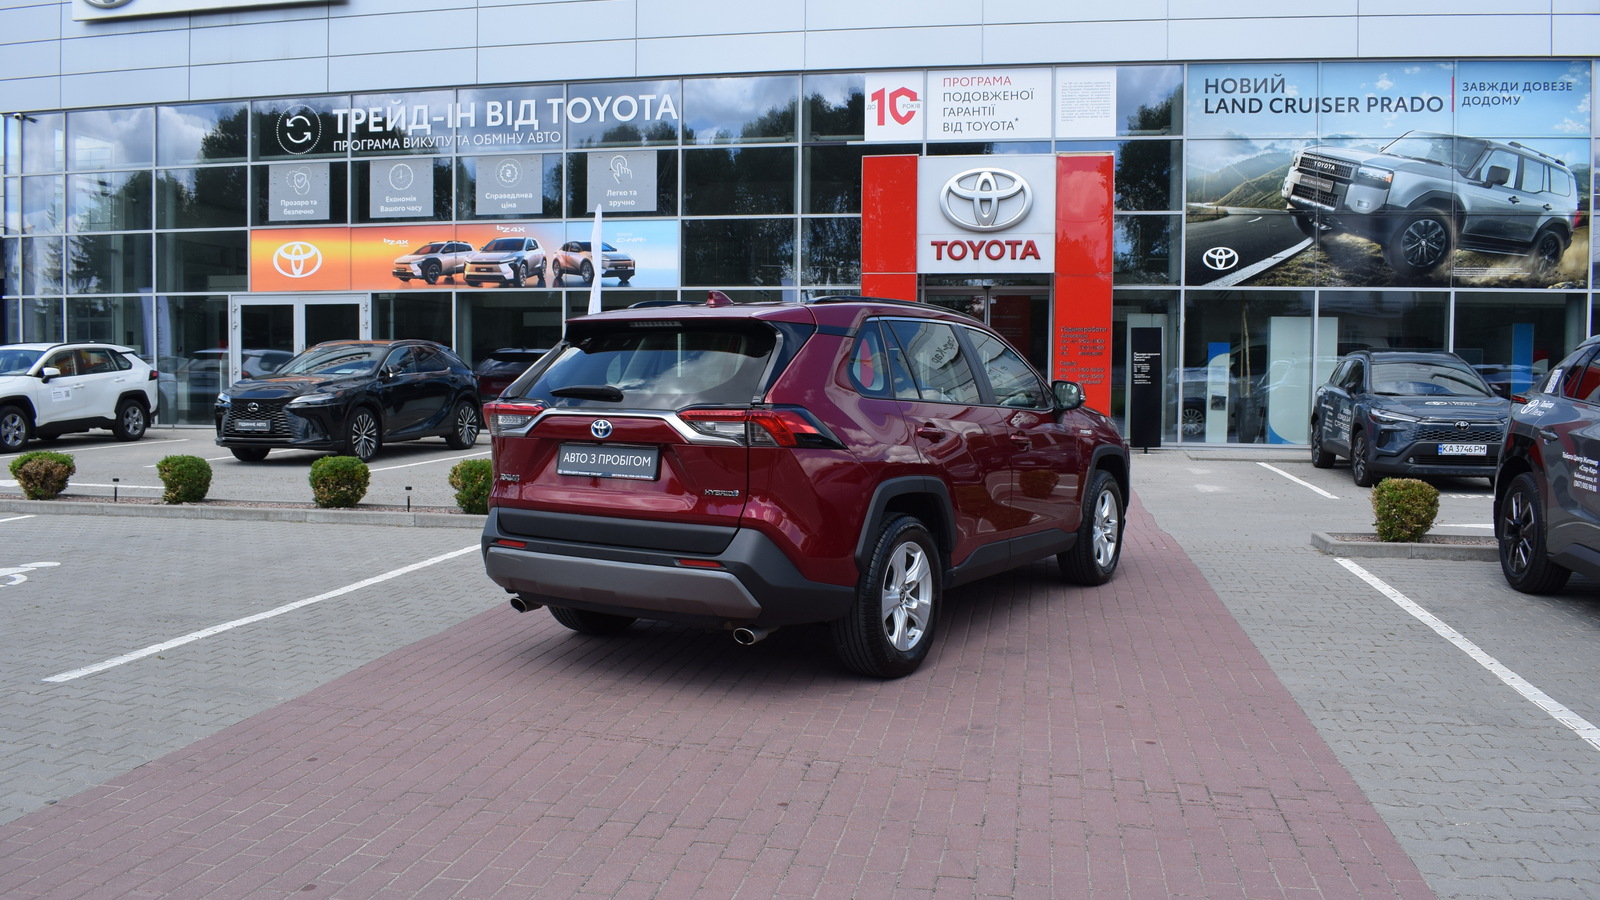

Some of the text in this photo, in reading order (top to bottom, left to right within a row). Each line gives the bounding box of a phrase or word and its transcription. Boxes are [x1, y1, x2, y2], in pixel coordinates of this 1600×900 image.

[943, 76, 1012, 88] ПРОГРАМА
[1204, 73, 1285, 94] НОВИЙ
[1462, 81, 1573, 93] ЗАВЖДИ ДОВЕЗЕ
[943, 88, 1035, 103] ПОДОВЖЕНОЇ
[1204, 96, 1444, 114] LAND CRUISER PRADO
[1461, 96, 1521, 107] ДОДОМУ
[332, 94, 679, 136] ТРЕЙД-ІН ВІД TOYOTA
[943, 104, 996, 117] ГАРАНТІЇ
[943, 122, 963, 133] ВІД
[333, 131, 561, 152] ПРОГРАМА ВИКУПУ ТА ОБМІНУ АВТО
[1314, 161, 1336, 170] TOYOTA
[385, 194, 417, 203] Економія
[485, 191, 533, 200] Справедлива
[606, 189, 628, 197] Легко
[280, 199, 309, 207] Прозоро
[380, 204, 423, 213] Вашого часу
[501, 201, 517, 209] ціна
[608, 199, 635, 207] зручно
[283, 207, 315, 215] безпечно
[930, 239, 1041, 261] TOYOTA
[563, 452, 651, 467] АВТО З ПРОБІГОМ
